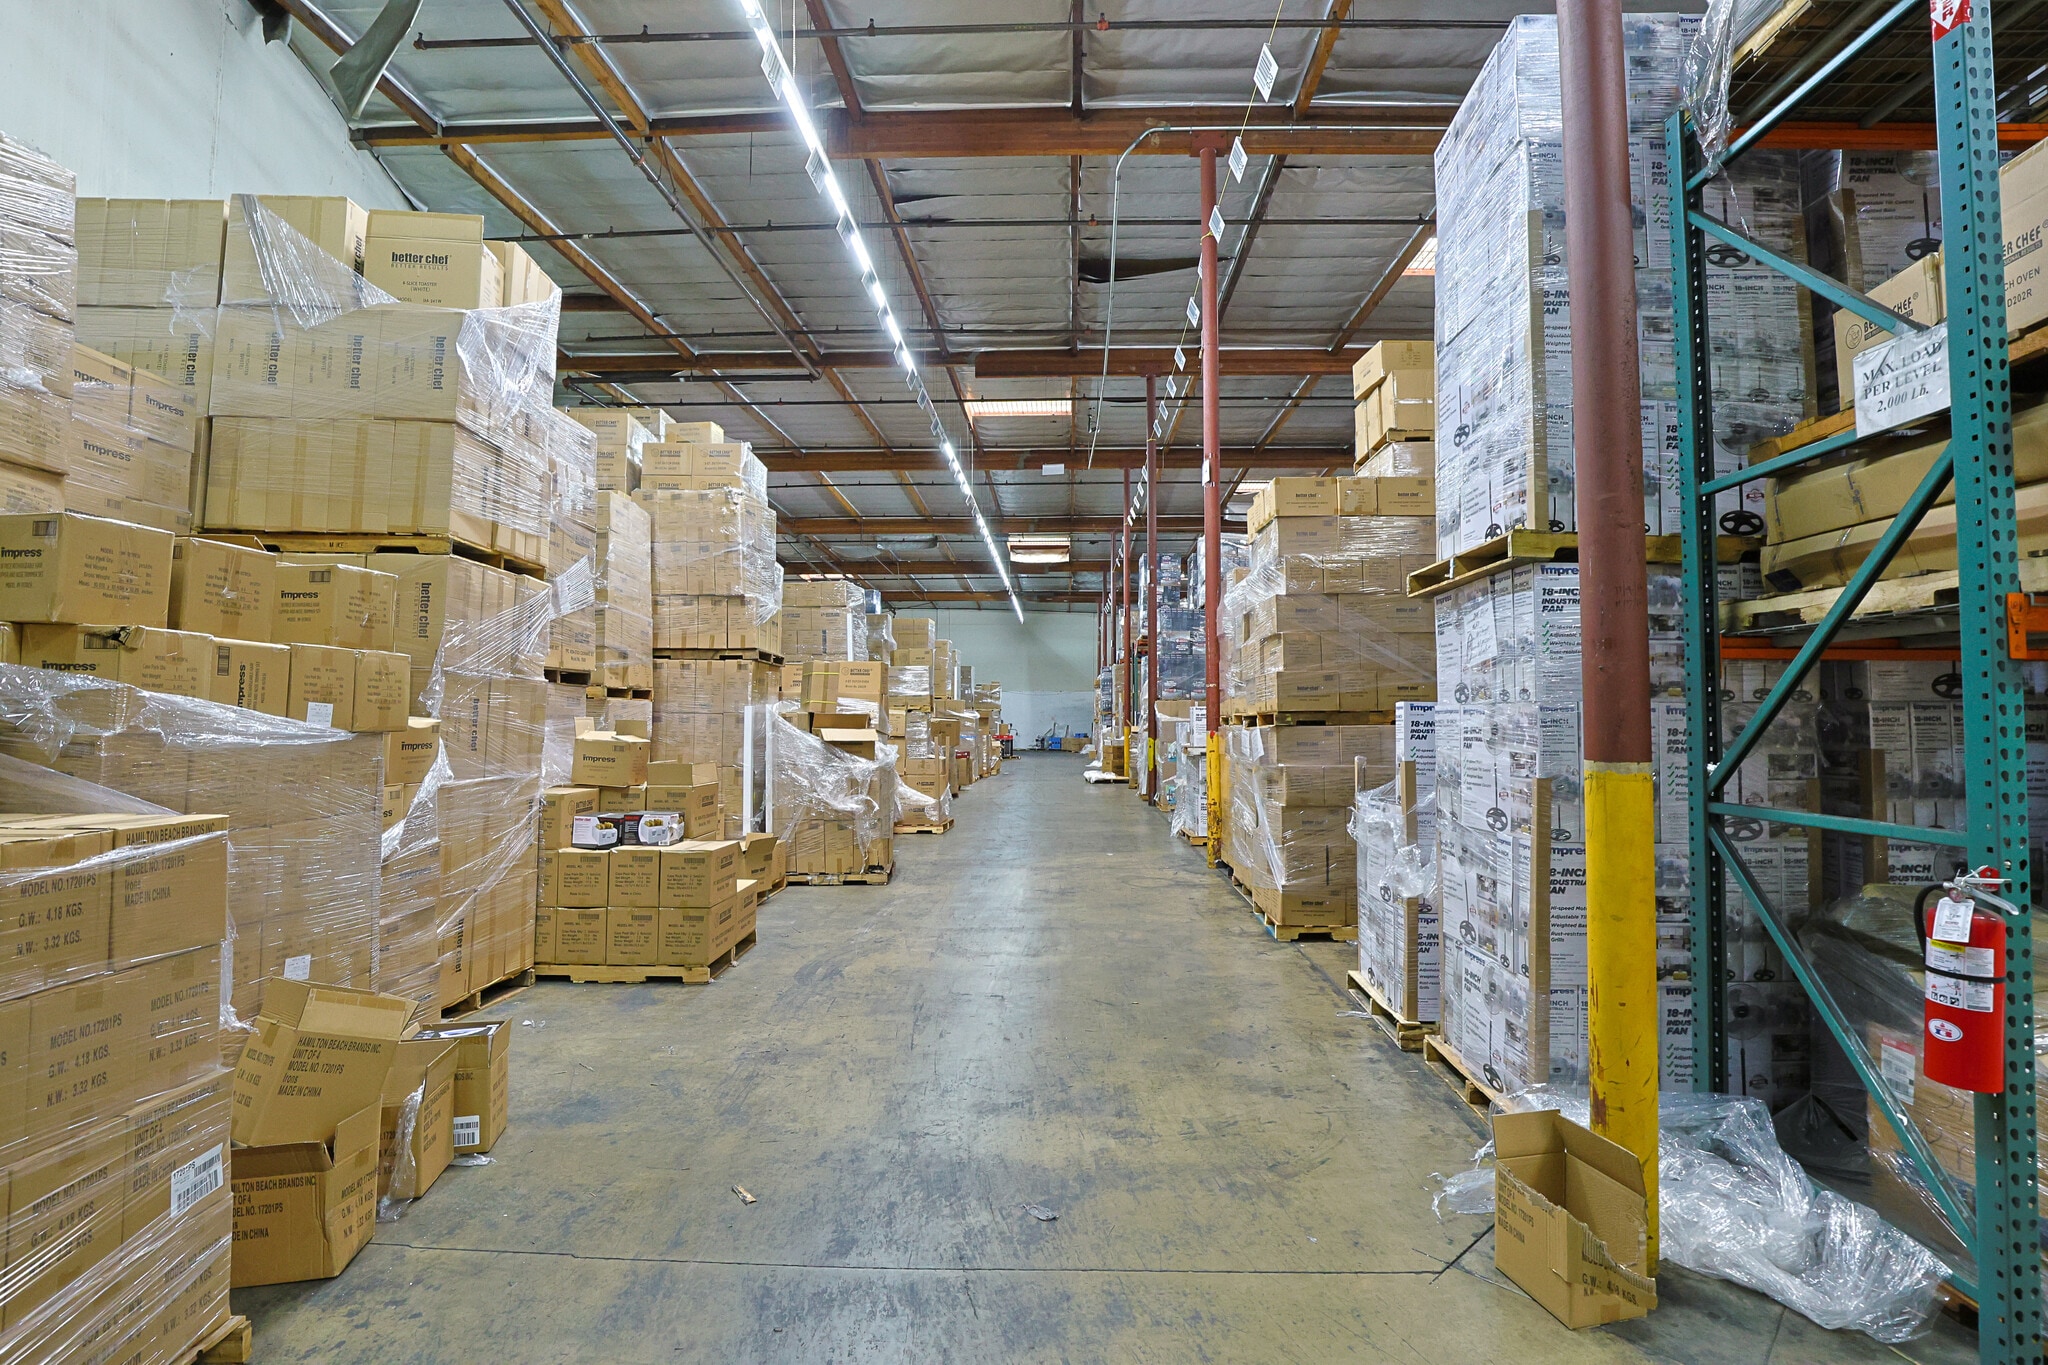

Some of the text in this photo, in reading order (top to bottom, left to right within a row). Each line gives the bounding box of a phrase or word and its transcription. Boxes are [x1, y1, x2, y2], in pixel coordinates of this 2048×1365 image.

[1849, 174, 1870, 183] FAN
[2015, 225, 2041, 249] CHEF
[391, 251, 449, 265] better chef
[2016, 266, 2040, 285] OVEN
[350, 335, 364, 389] better chef
[1902, 341, 1942, 368] LOAD
[432, 336, 446, 390] better chef
[184, 364, 196, 386] chef
[267, 365, 280, 387] chef
[1864, 362, 1942, 400] PER LEVEL
[145, 394, 185, 417] impress
[83, 439, 132, 462] impress
[0, 547, 42, 559] impress
[1540, 565, 1578, 576] impre
[281, 590, 318, 600] impress
[418, 582, 432, 638] better chef
[42, 660, 96, 672] impress
[1410, 704, 1435, 713] impr
[401, 742, 433, 752] impress
[470, 730, 478, 752] chef
[582, 754, 616, 763] impress
[160, 826, 180, 842] BEACH
[181, 824, 204, 838] BRANDS
[125, 862, 148, 877] MODEL
[161, 854, 185, 870] 17201PS
[1888, 864, 1932, 874] 8-INCH
[20, 883, 49, 898] MODEL
[125, 886, 171, 907] MADE IN CHINA
[46, 906, 62, 922] 4.18
[43, 934, 60, 951] 3.32
[150, 994, 173, 1012] MODEL
[1666, 1027, 1688, 1035] FAN
[50, 1029, 78, 1050] MODEL
[170, 1040, 182, 1054] 3.32
[298, 1036, 382, 1054] HAMILTON BEACH BRANDS INC.
[75, 1052, 89, 1068] 4.18
[93, 1044, 111, 1063] KGS.
[292, 1049, 308, 1059] UNIT
[308, 1050, 316, 1059] OF
[287, 1060, 345, 1075] MODEL NO. 17201PS
[282, 1072, 298, 1083] Irons
[72, 1079, 88, 1098] 3.32
[277, 1085, 295, 1096] MADE
[303, 1086, 322, 1097] CHINA
[231, 1176, 304, 1194] MILTON BEACH BRANDS
[341, 1184, 356, 1199] MODEL
[238, 1195, 247, 1204] OF
[232, 1202, 283, 1218] DEL NO. 17201PS
[241, 1227, 269, 1240] IN CHINA
